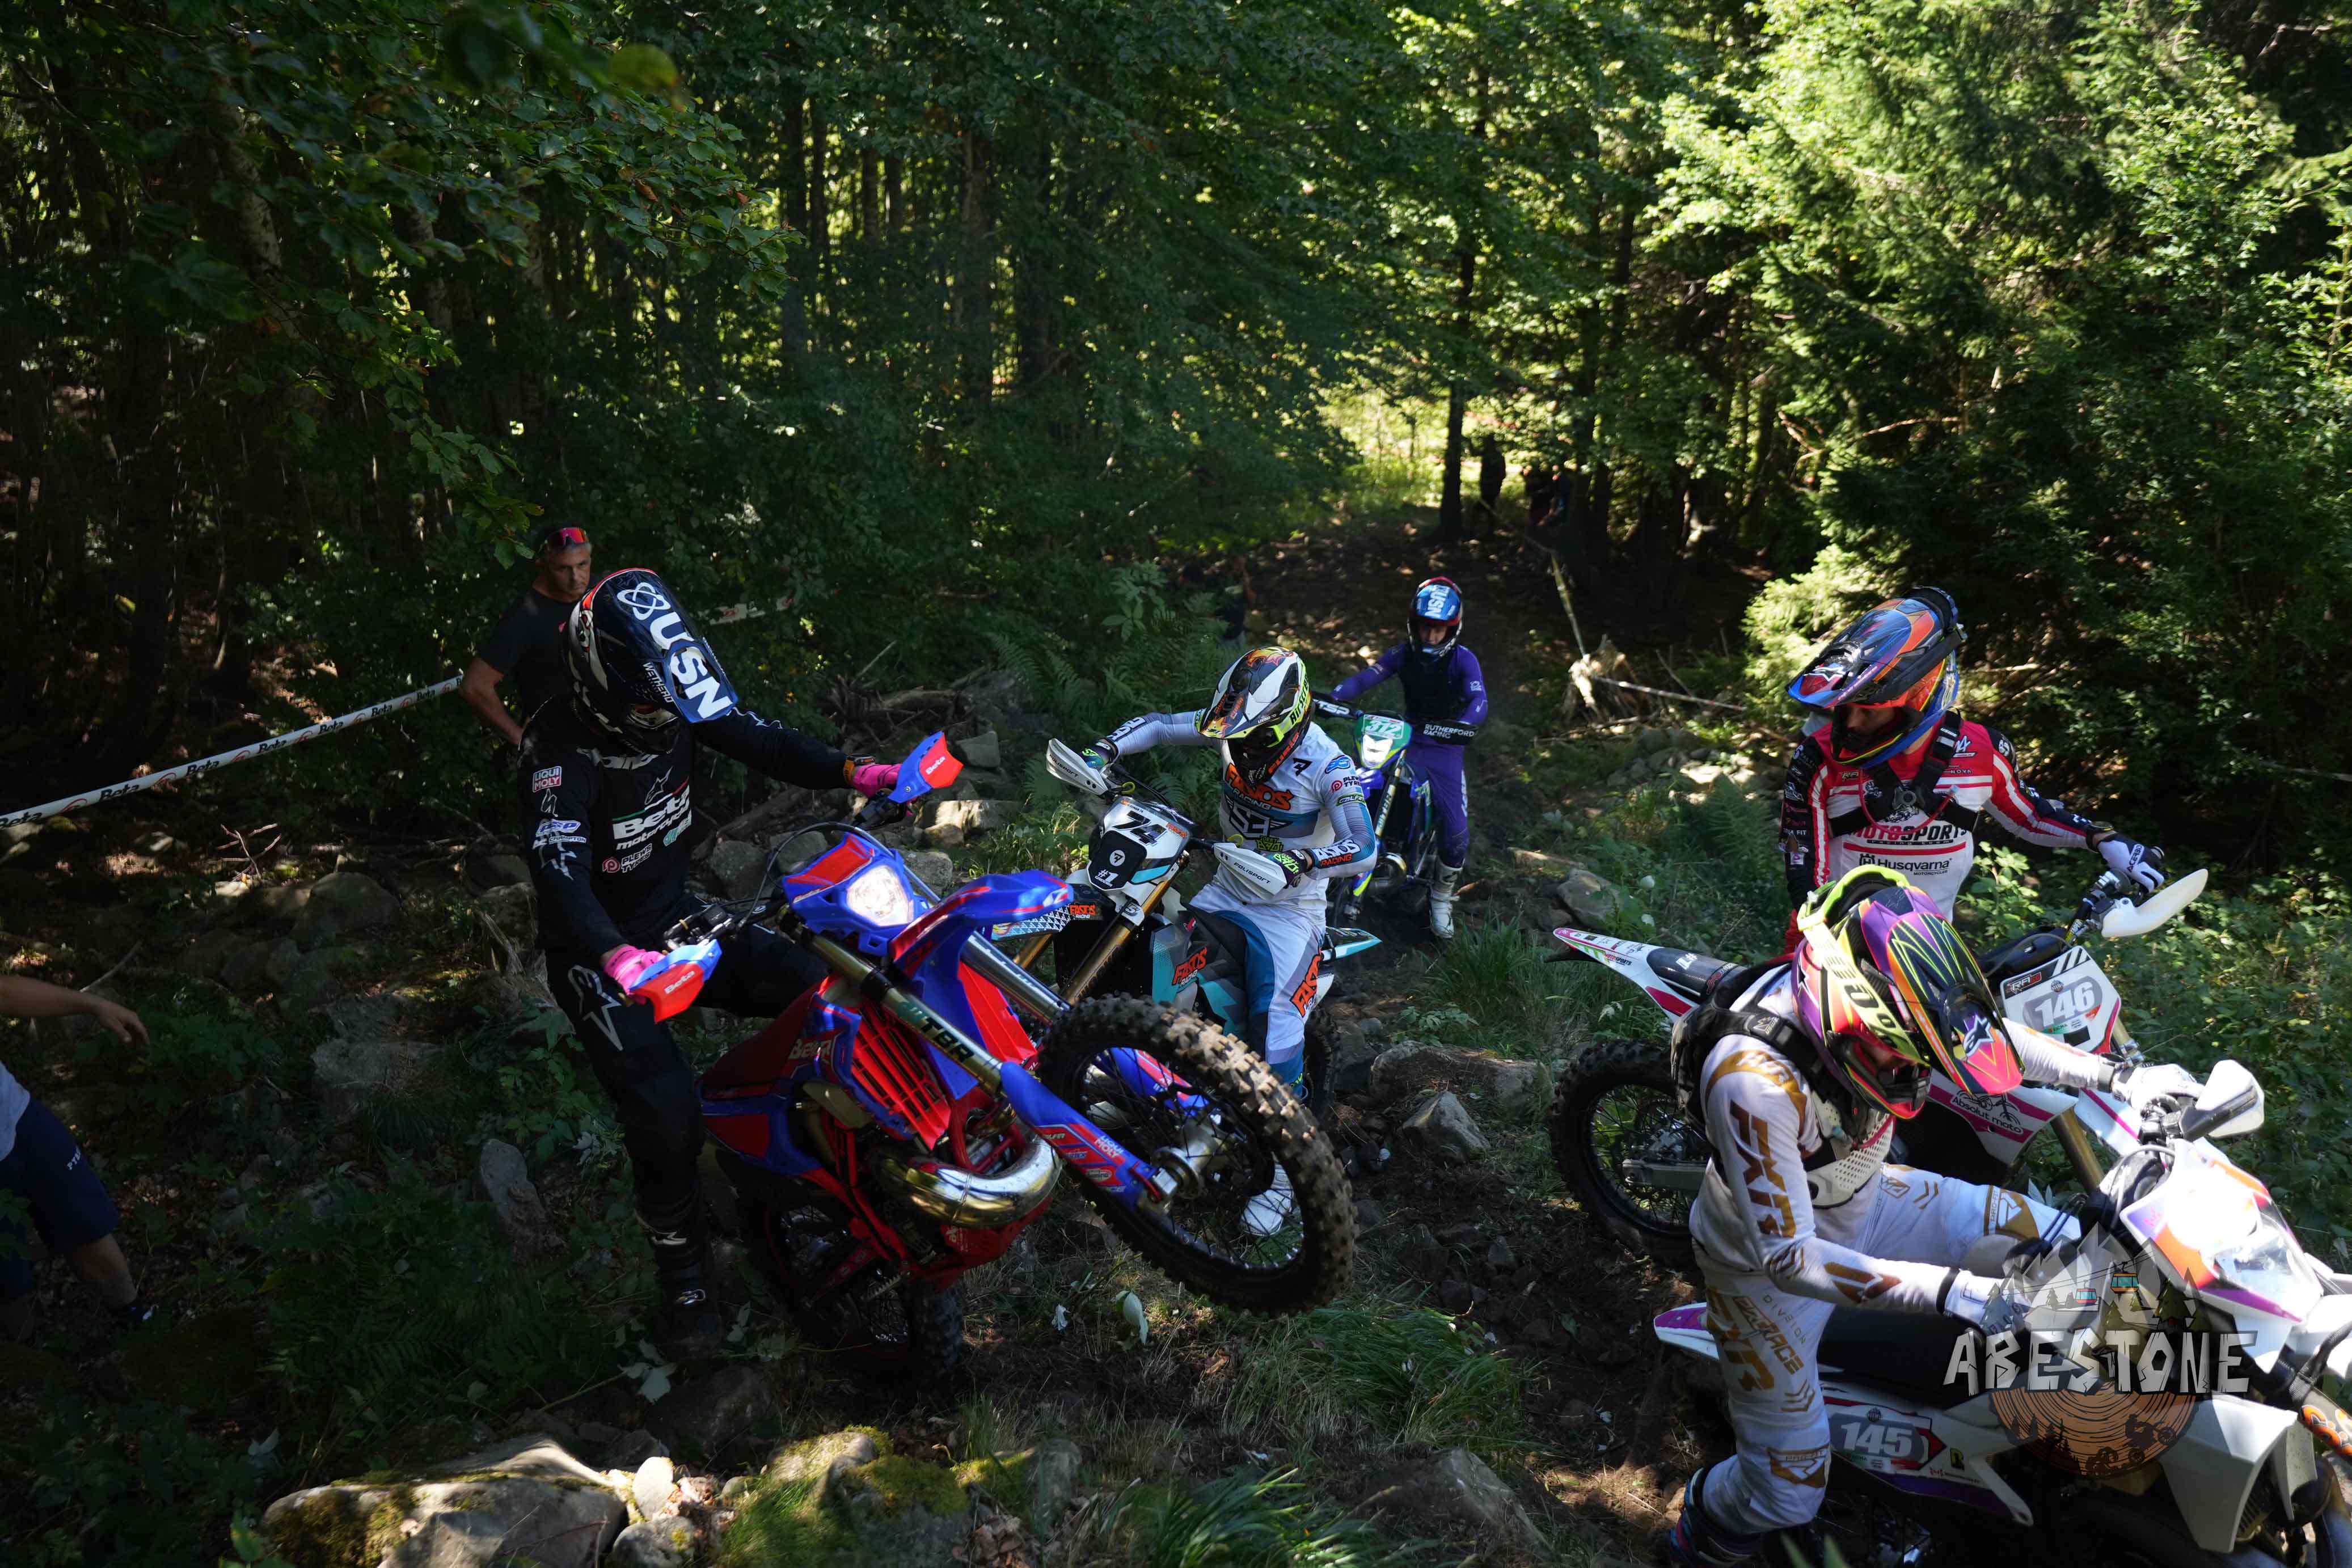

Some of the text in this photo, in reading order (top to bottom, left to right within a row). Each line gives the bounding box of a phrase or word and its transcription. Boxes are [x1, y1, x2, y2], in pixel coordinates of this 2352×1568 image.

[650, 612, 733, 719] USN
[1365, 720, 1402, 734] 312
[1425, 724, 1475, 737] RUTHERFORD
[187, 759, 220, 776] Beta
[535, 768, 559, 780] LIQUI
[926, 756, 945, 775] Beta
[1049, 754, 1079, 777] POLISPORT
[534, 776, 559, 790] MOLY
[1112, 810, 1167, 846] 74
[1234, 862, 1270, 884] POLISPORT
[1878, 859, 1950, 870] Husqvarna
[2034, 982, 2095, 1027] 146
[1952, 1097, 2021, 1133] Absolut moto
[1094, 1138, 1117, 1158] MOLY
[1841, 1422, 1912, 1457] 145
